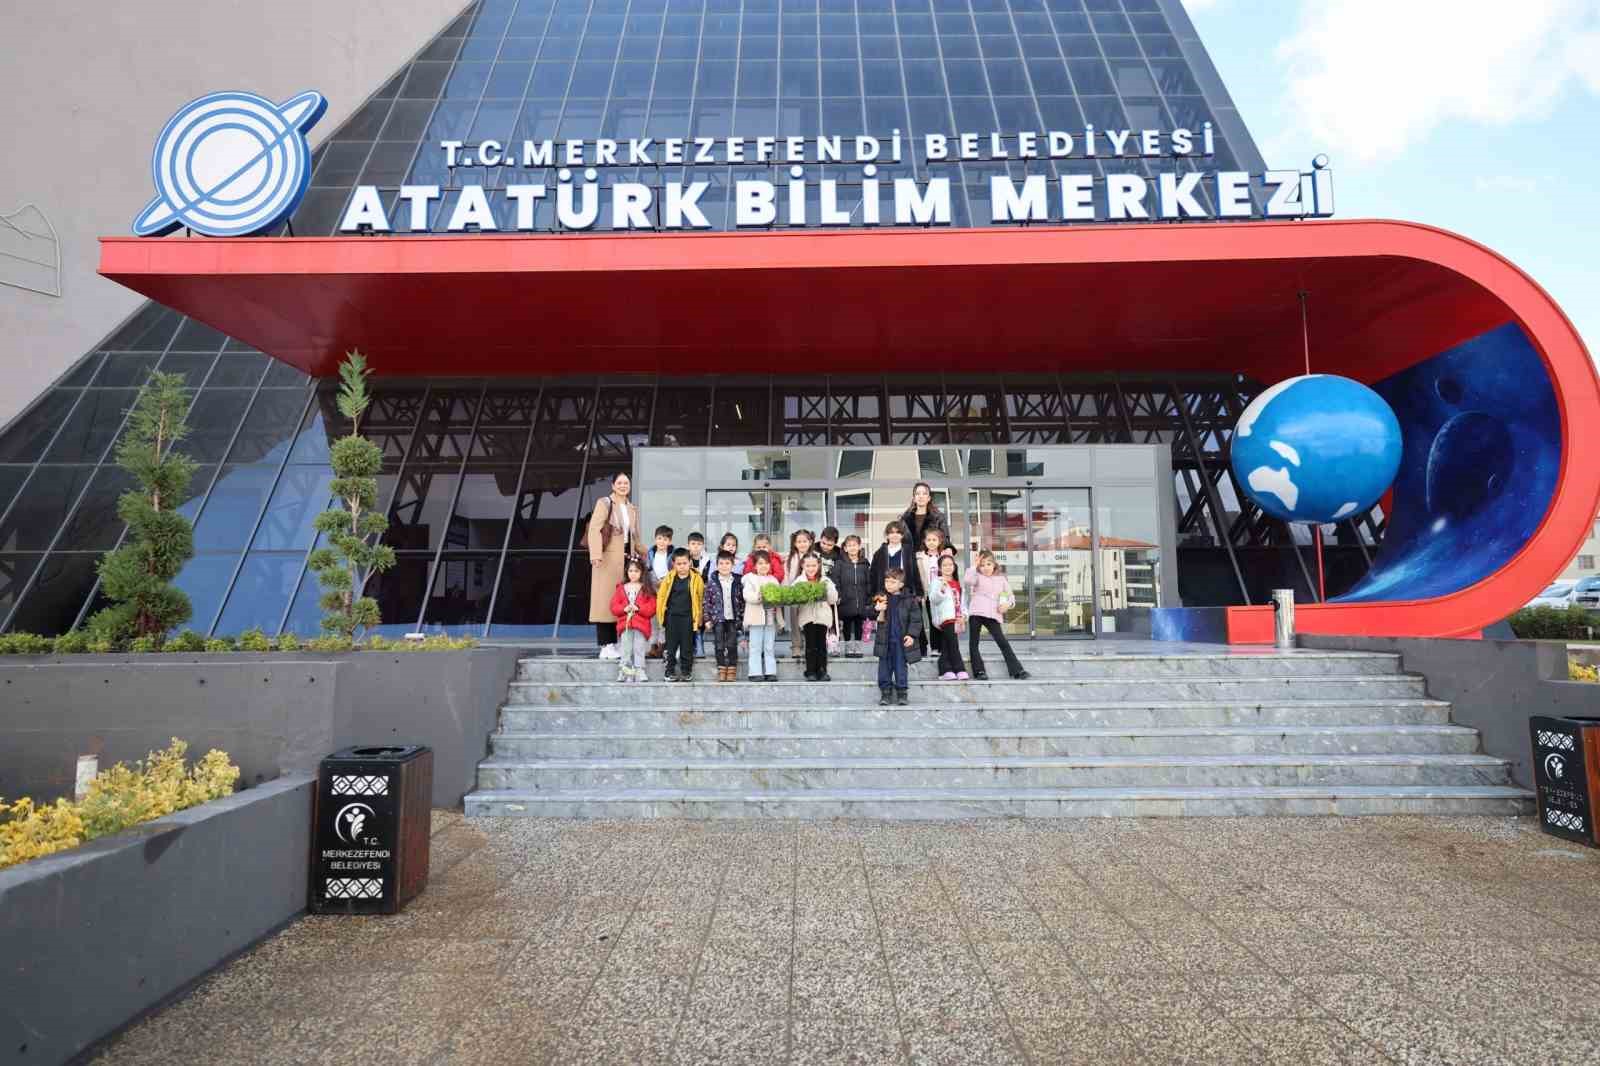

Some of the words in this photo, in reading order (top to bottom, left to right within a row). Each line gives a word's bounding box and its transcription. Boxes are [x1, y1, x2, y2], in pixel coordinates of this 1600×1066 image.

[925, 121, 1214, 158] BELEDİYESİ
[340, 168, 712, 231] ATATÜRK
[736, 164, 951, 228] BİLİM
[990, 153, 1334, 223] MERKEZİ
